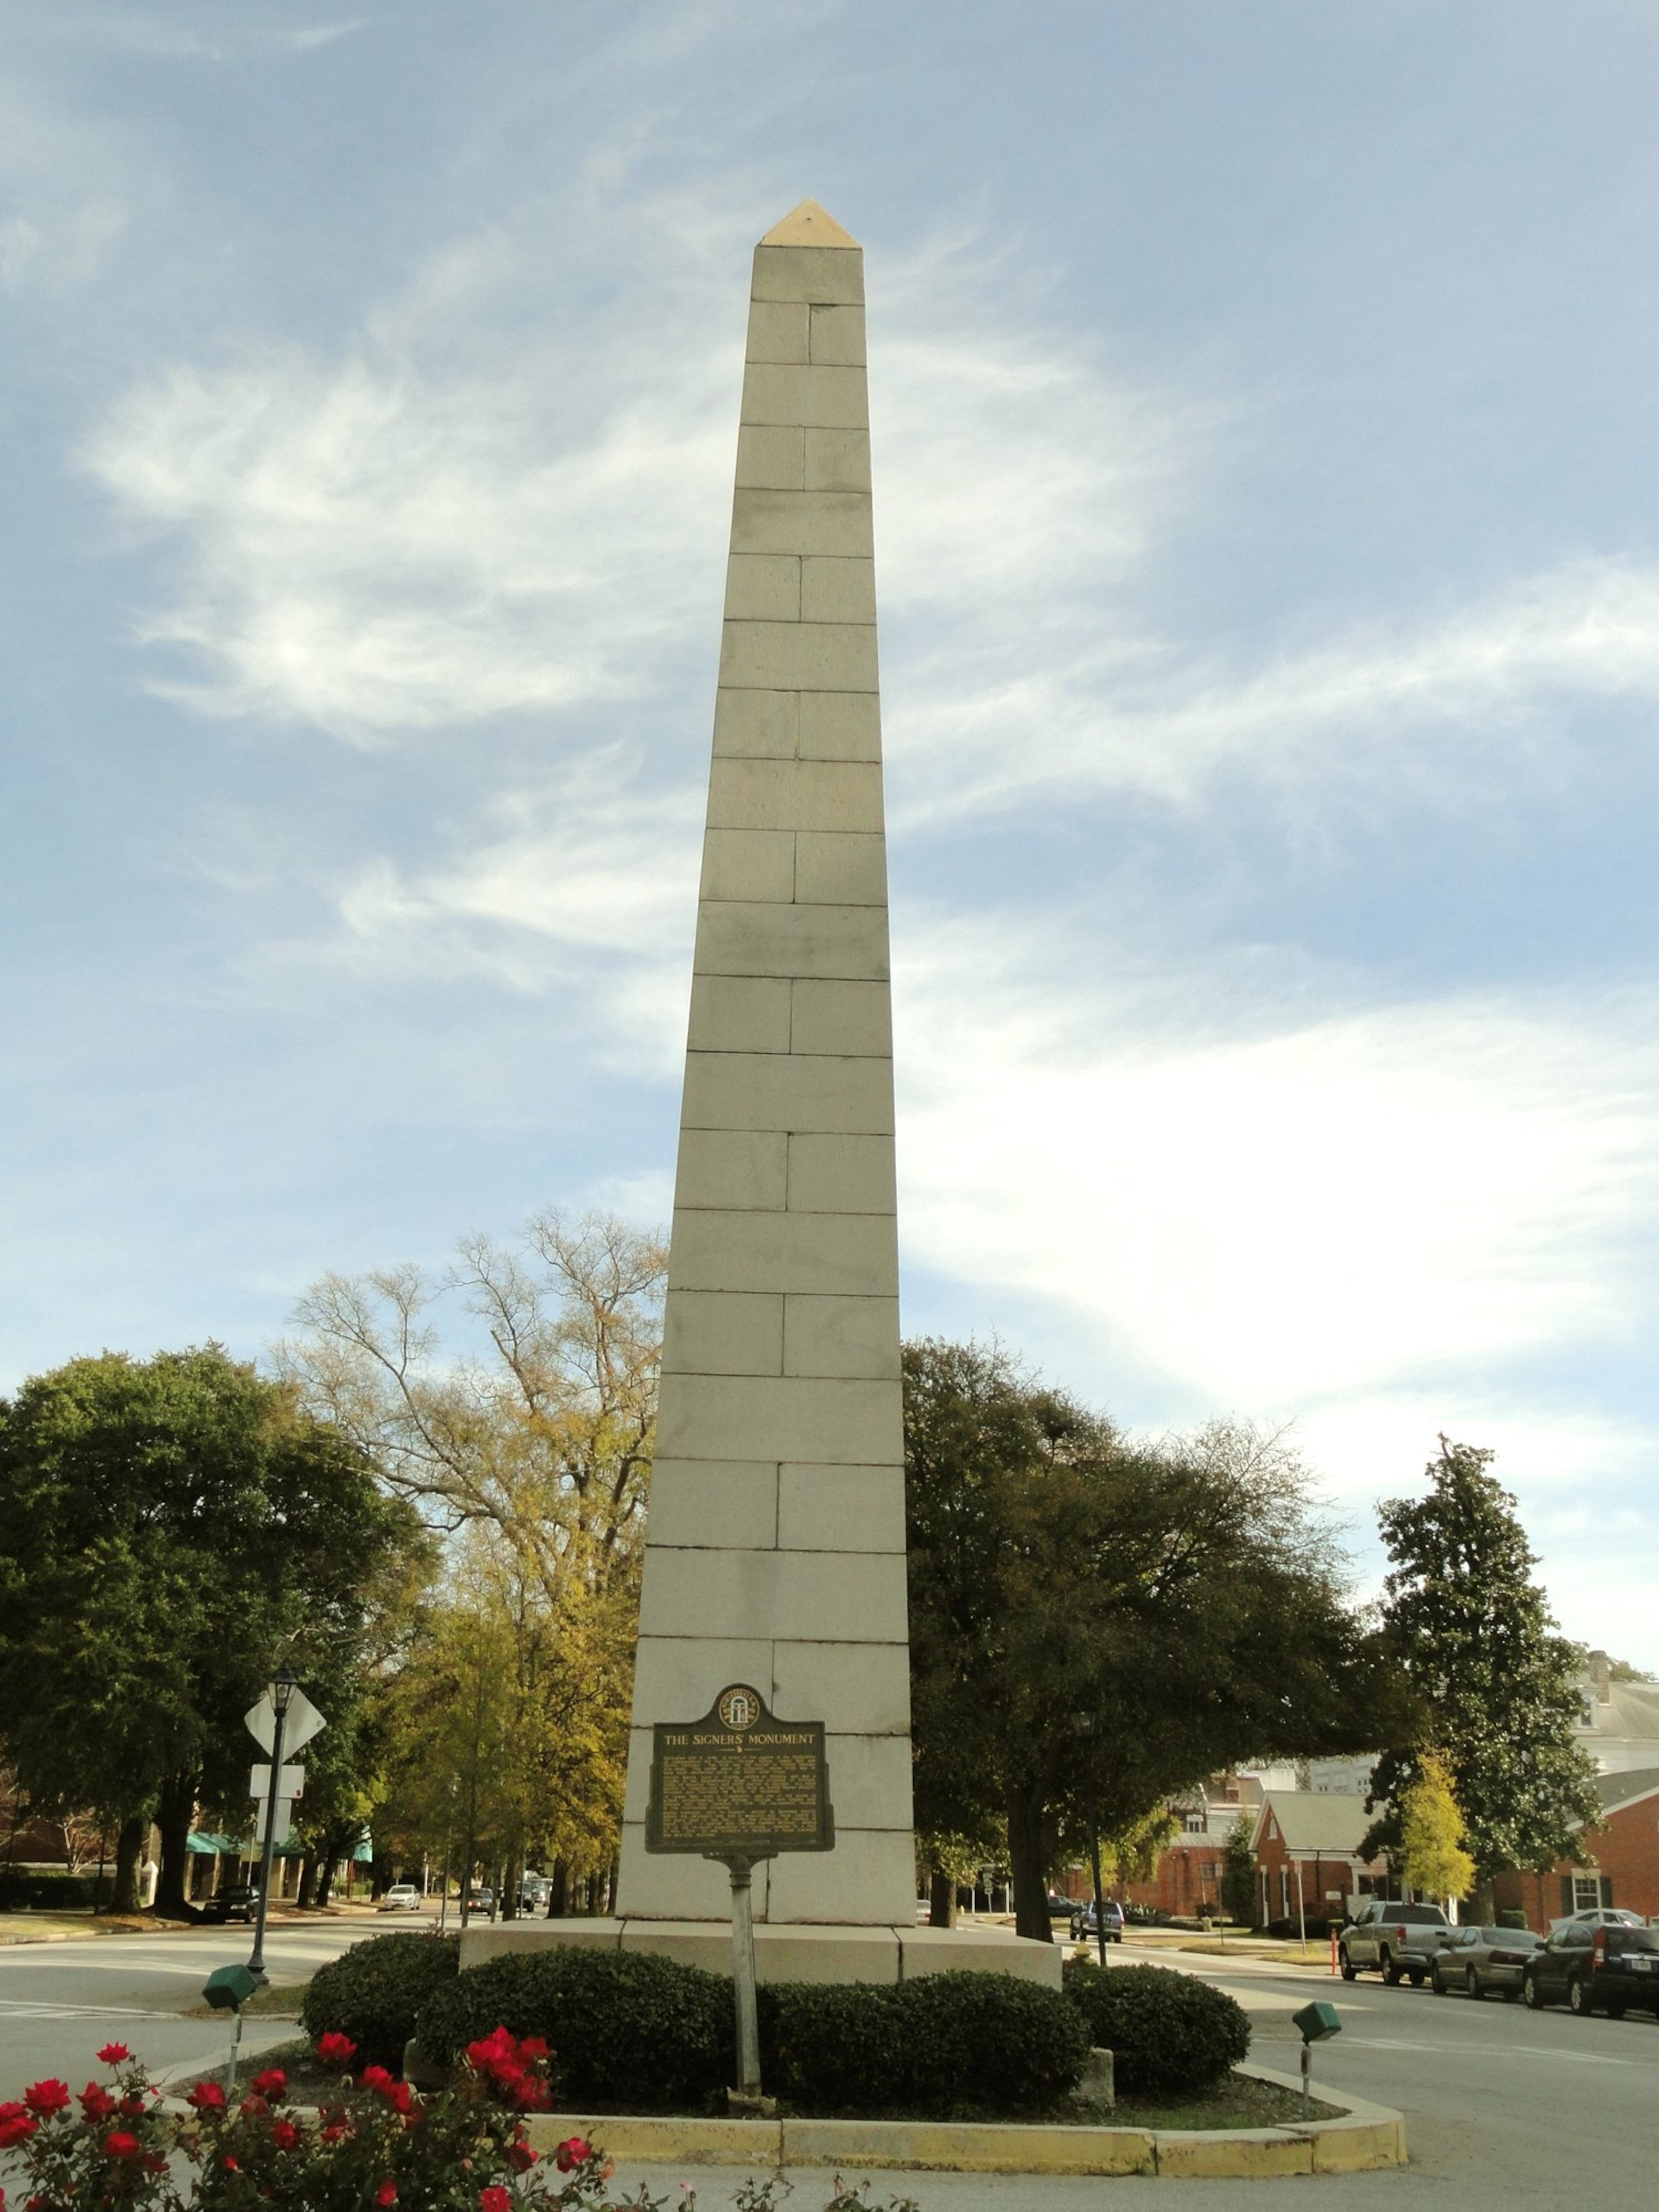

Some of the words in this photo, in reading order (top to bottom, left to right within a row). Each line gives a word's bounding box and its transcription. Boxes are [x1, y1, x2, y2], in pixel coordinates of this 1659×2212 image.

[664, 1735, 689, 1745] THE
[693, 1734, 745, 1745] SIGNERS'
[748, 1733, 816, 1745] MONUMENT
